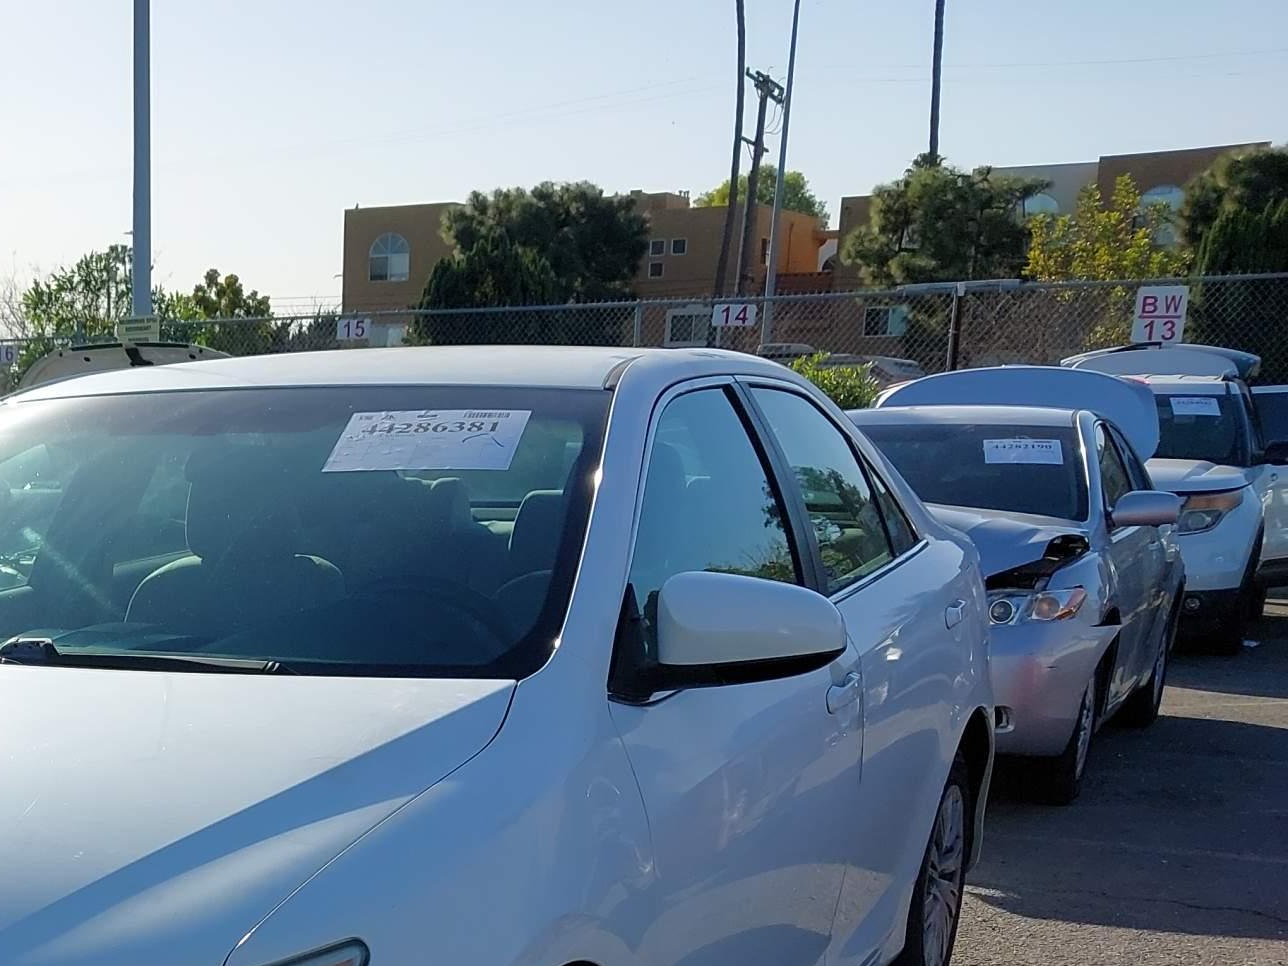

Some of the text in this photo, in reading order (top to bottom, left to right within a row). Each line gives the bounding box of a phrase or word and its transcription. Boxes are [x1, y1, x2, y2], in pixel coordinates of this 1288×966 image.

[722, 305, 749, 325] 14
[343, 320, 365, 338] 15
[1143, 319, 1176, 341] 13
[362, 421, 500, 434] 44286381
